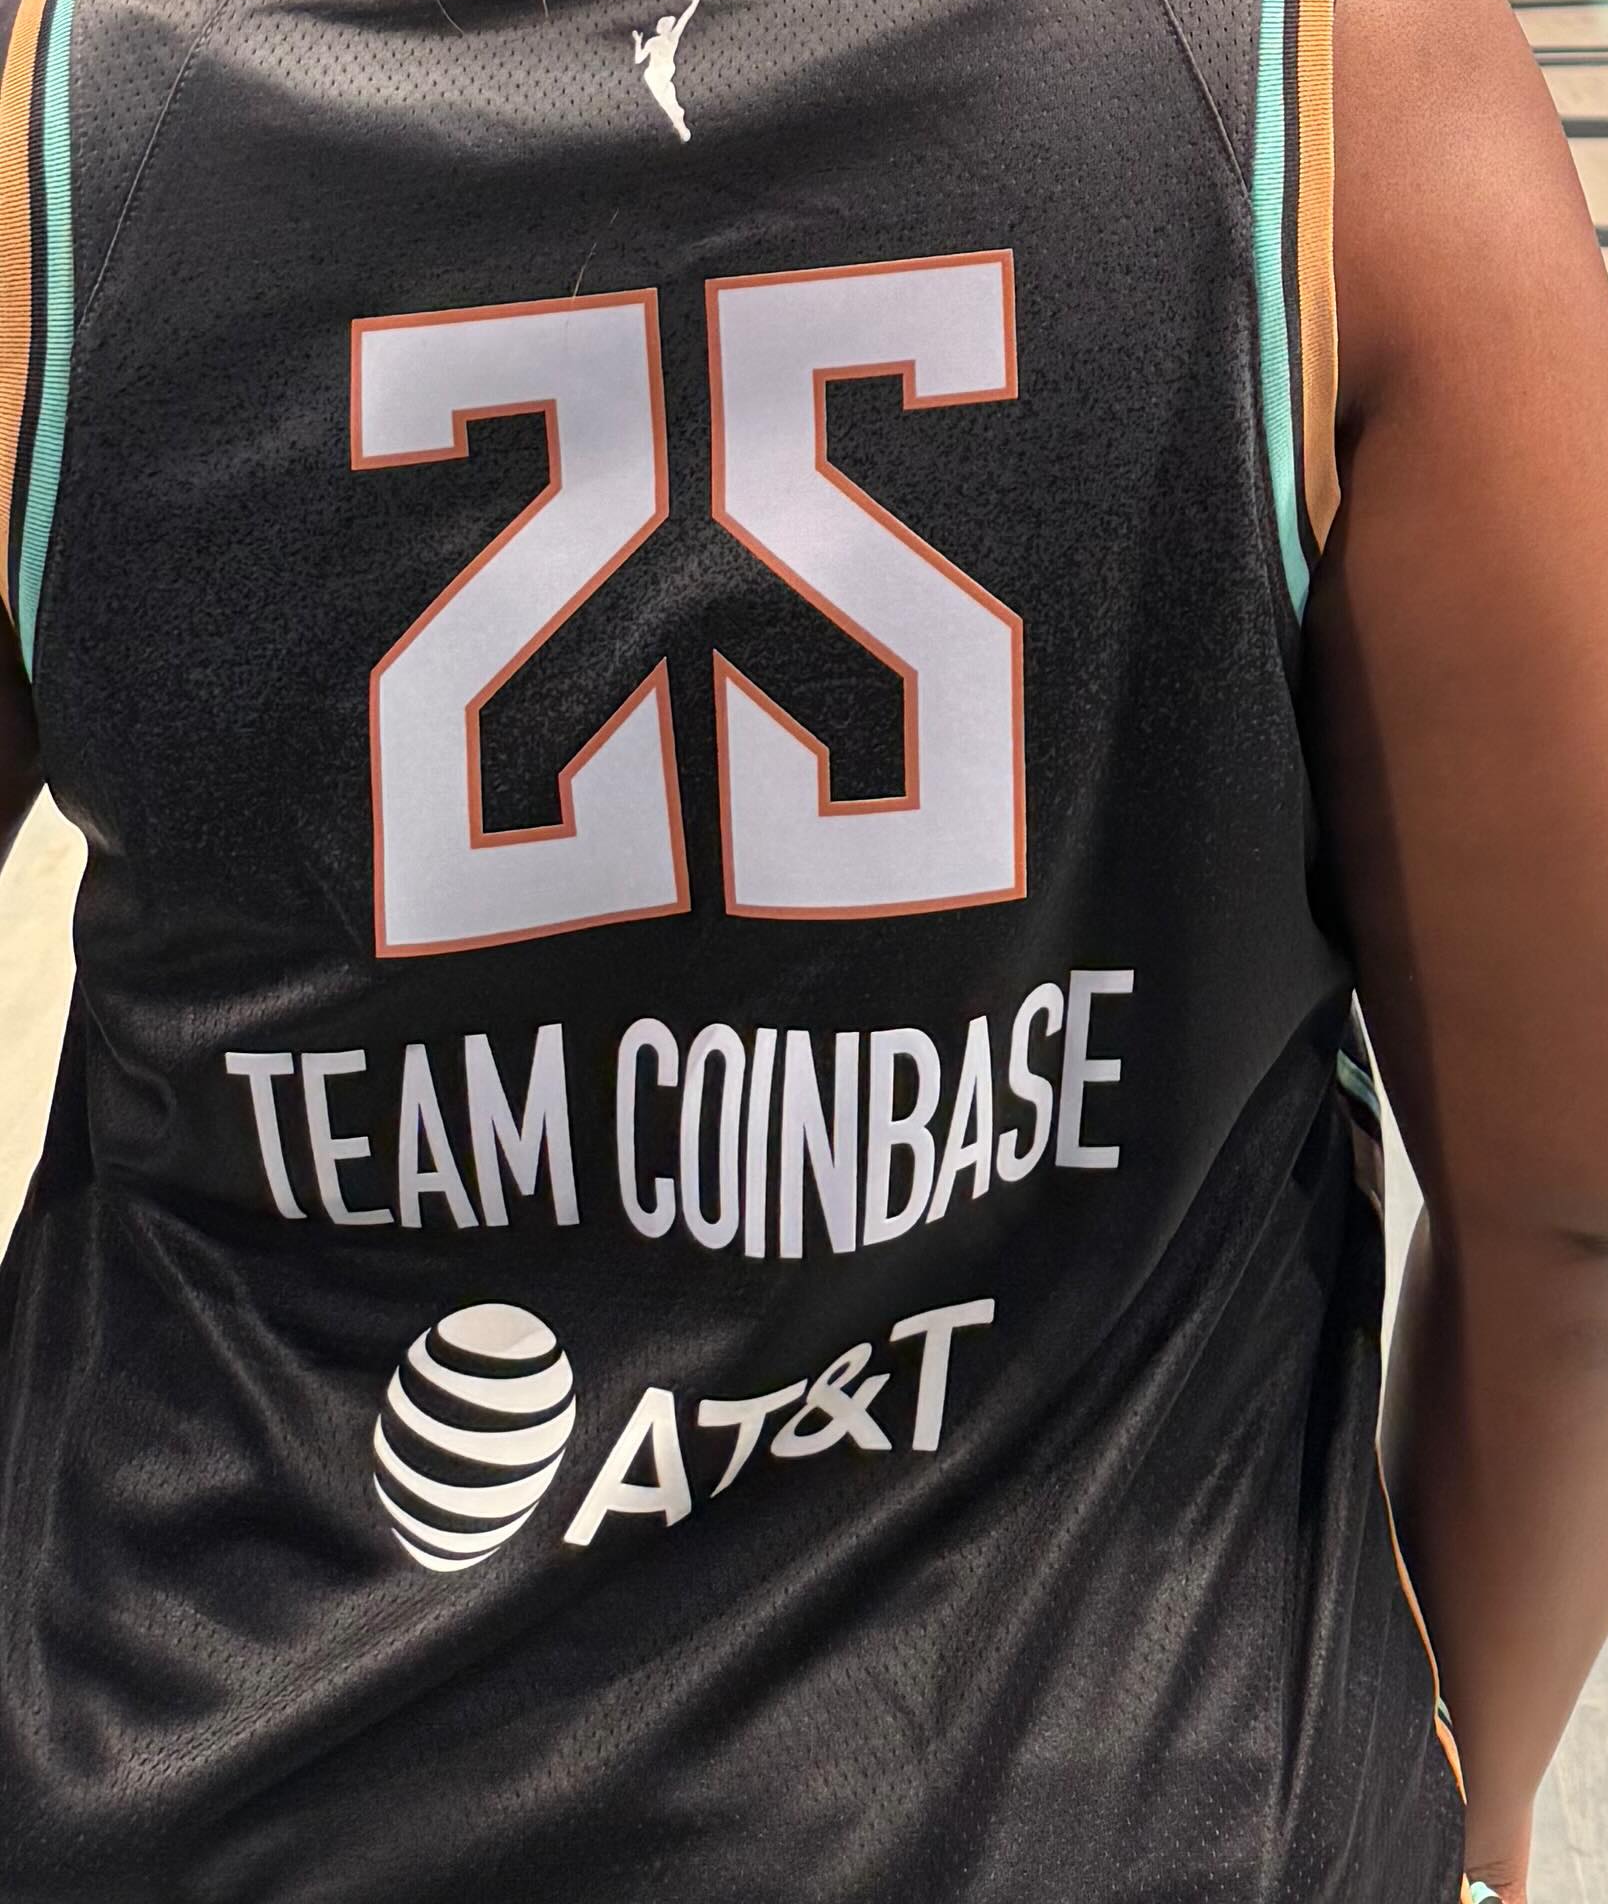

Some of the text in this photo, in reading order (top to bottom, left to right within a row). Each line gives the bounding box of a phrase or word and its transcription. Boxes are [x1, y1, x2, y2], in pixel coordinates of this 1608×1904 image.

[350, 248, 1028, 959] 25
[225, 969, 1134, 1259] TEAM COINBASE
[563, 1297, 995, 1546] AT&T
